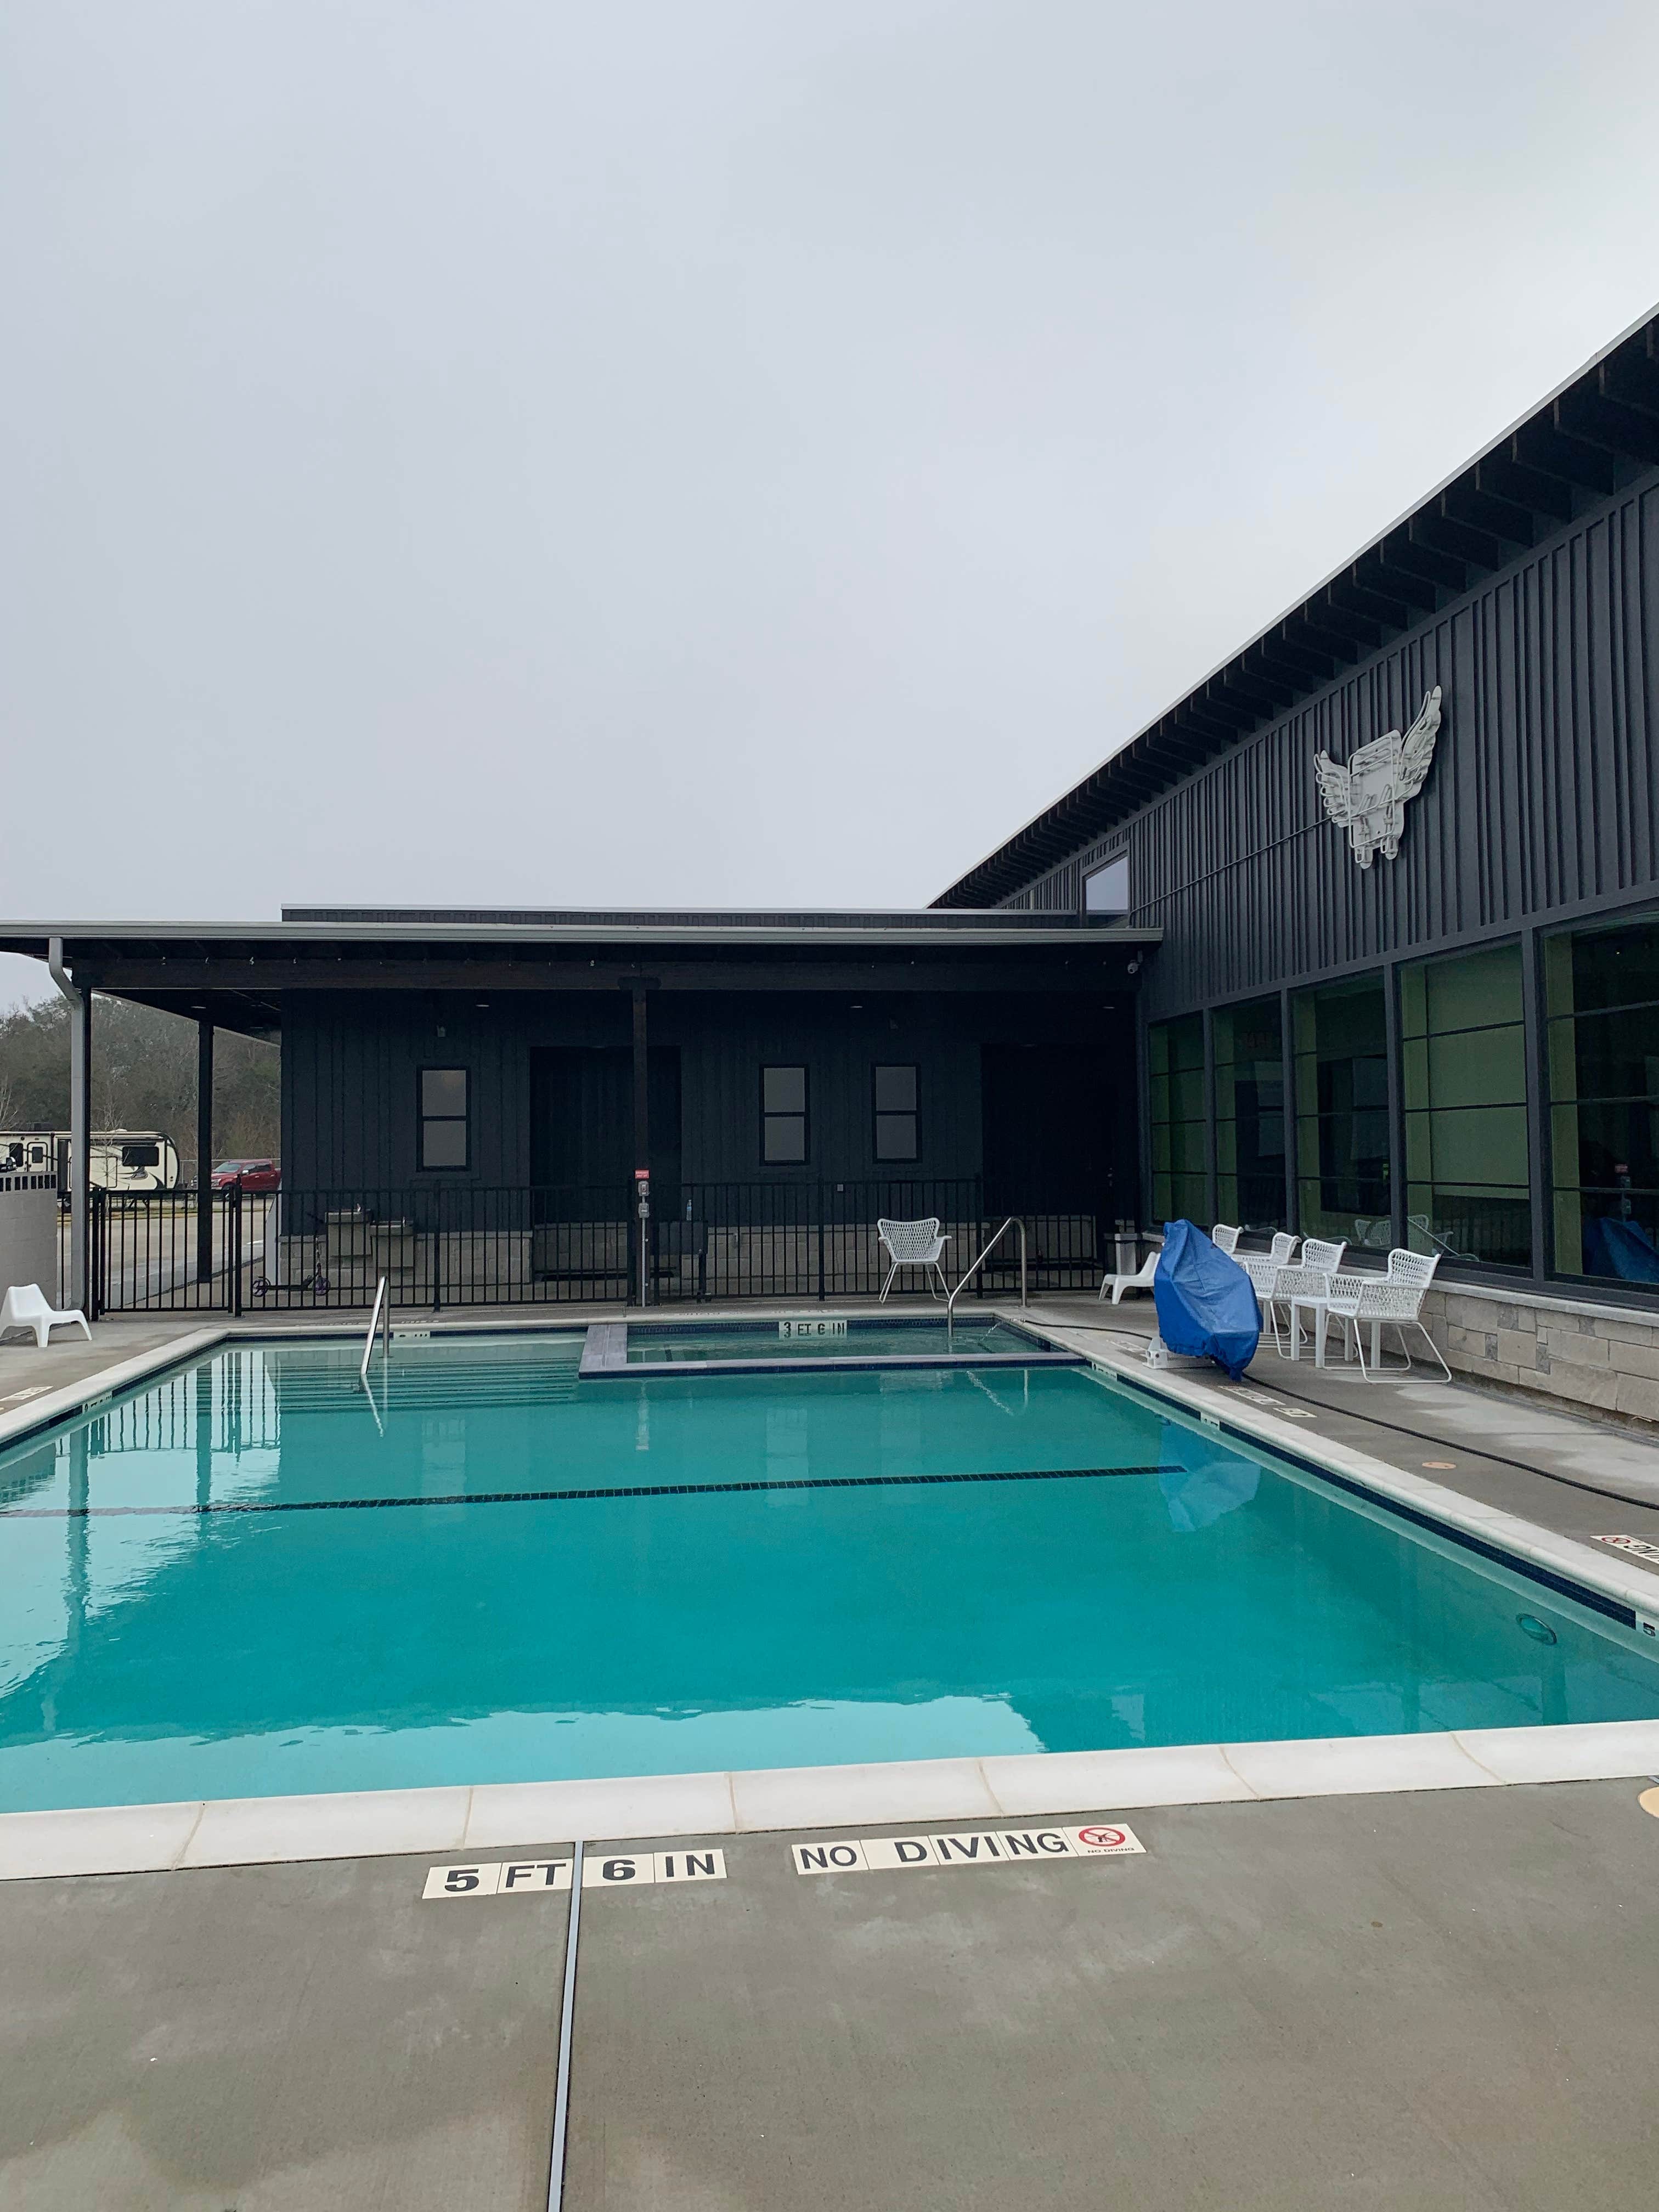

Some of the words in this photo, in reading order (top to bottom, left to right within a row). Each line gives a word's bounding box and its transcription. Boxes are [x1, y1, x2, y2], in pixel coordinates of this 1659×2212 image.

[799, 1846, 857, 1870] NO
[895, 1832, 1070, 1863] DIVING
[444, 1869, 480, 1892] 5
[505, 1863, 567, 1888] FT
[602, 1859, 636, 1881] 6
[665, 1853, 715, 1877] IN
